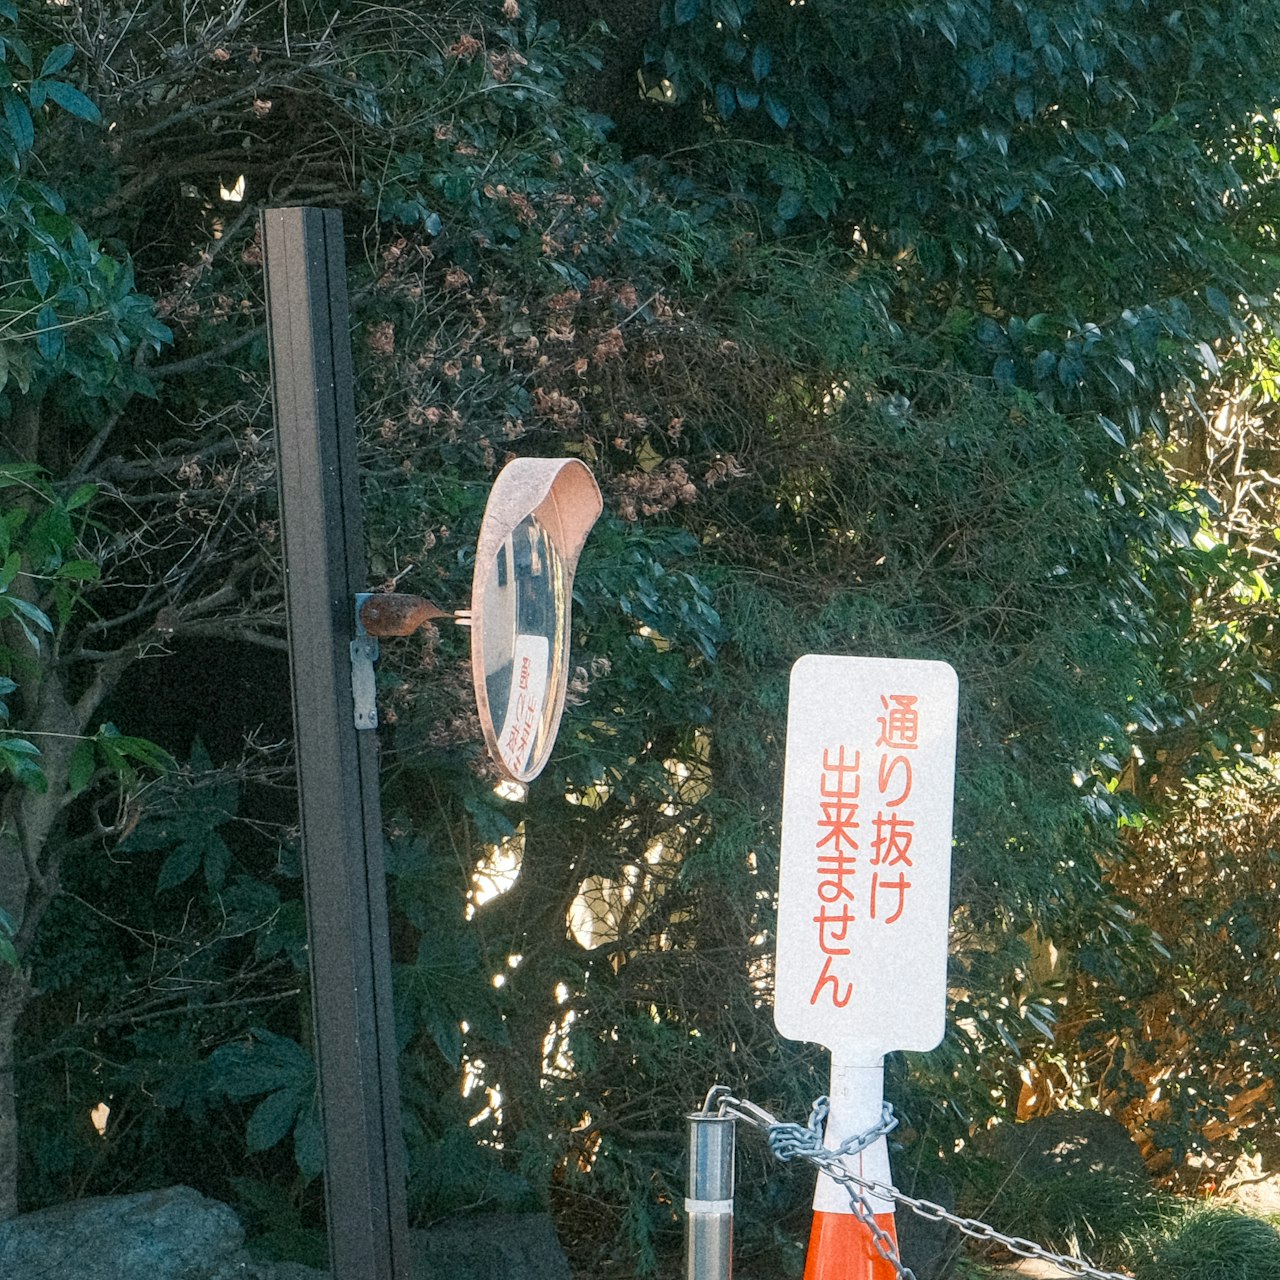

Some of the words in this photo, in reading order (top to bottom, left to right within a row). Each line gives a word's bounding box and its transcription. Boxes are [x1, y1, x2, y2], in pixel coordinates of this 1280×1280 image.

[810, 744, 861, 1009] 出来ません
[870, 694, 919, 924] 通り抜け
